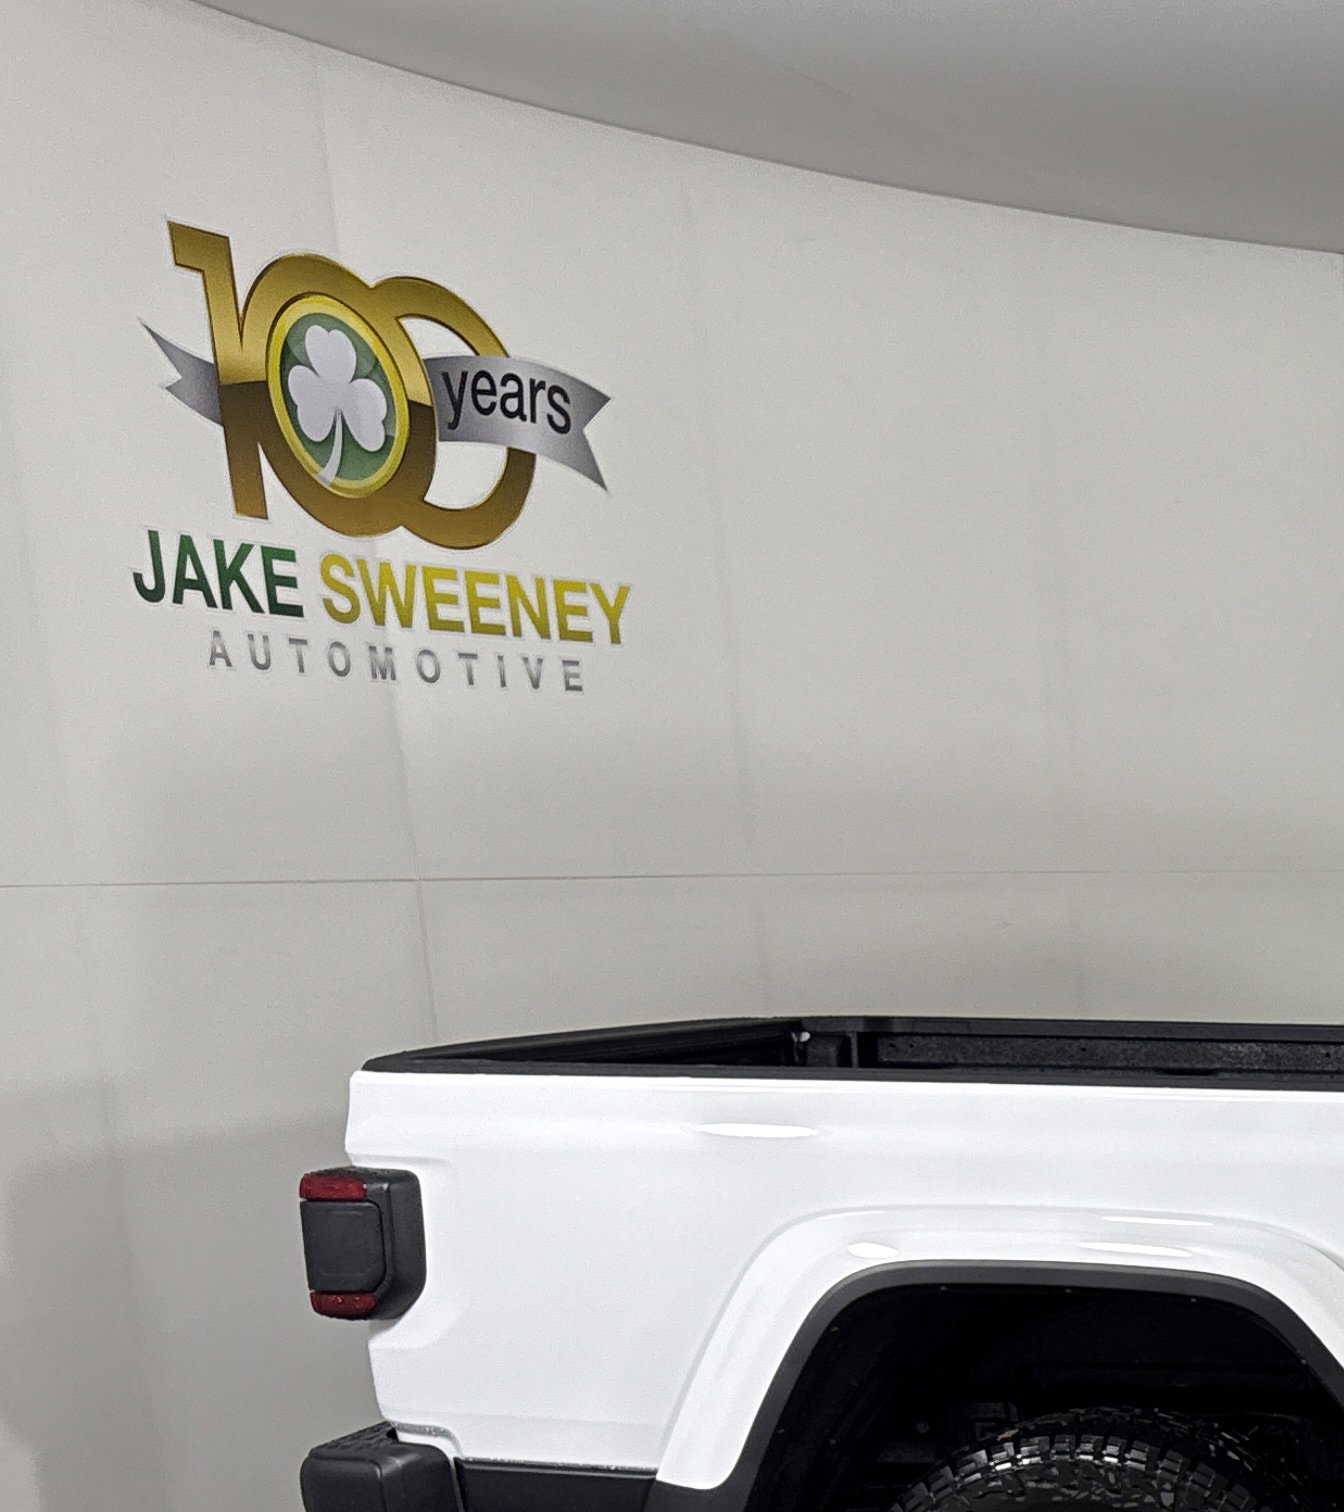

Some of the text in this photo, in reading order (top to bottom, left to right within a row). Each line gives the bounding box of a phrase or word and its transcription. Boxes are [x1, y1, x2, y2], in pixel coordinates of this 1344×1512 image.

[169, 220, 536, 549] 100
[441, 368, 572, 435] years
[133, 529, 631, 646] JAKE SWEENEY
[209, 630, 584, 692] AUTOMOTIVE
